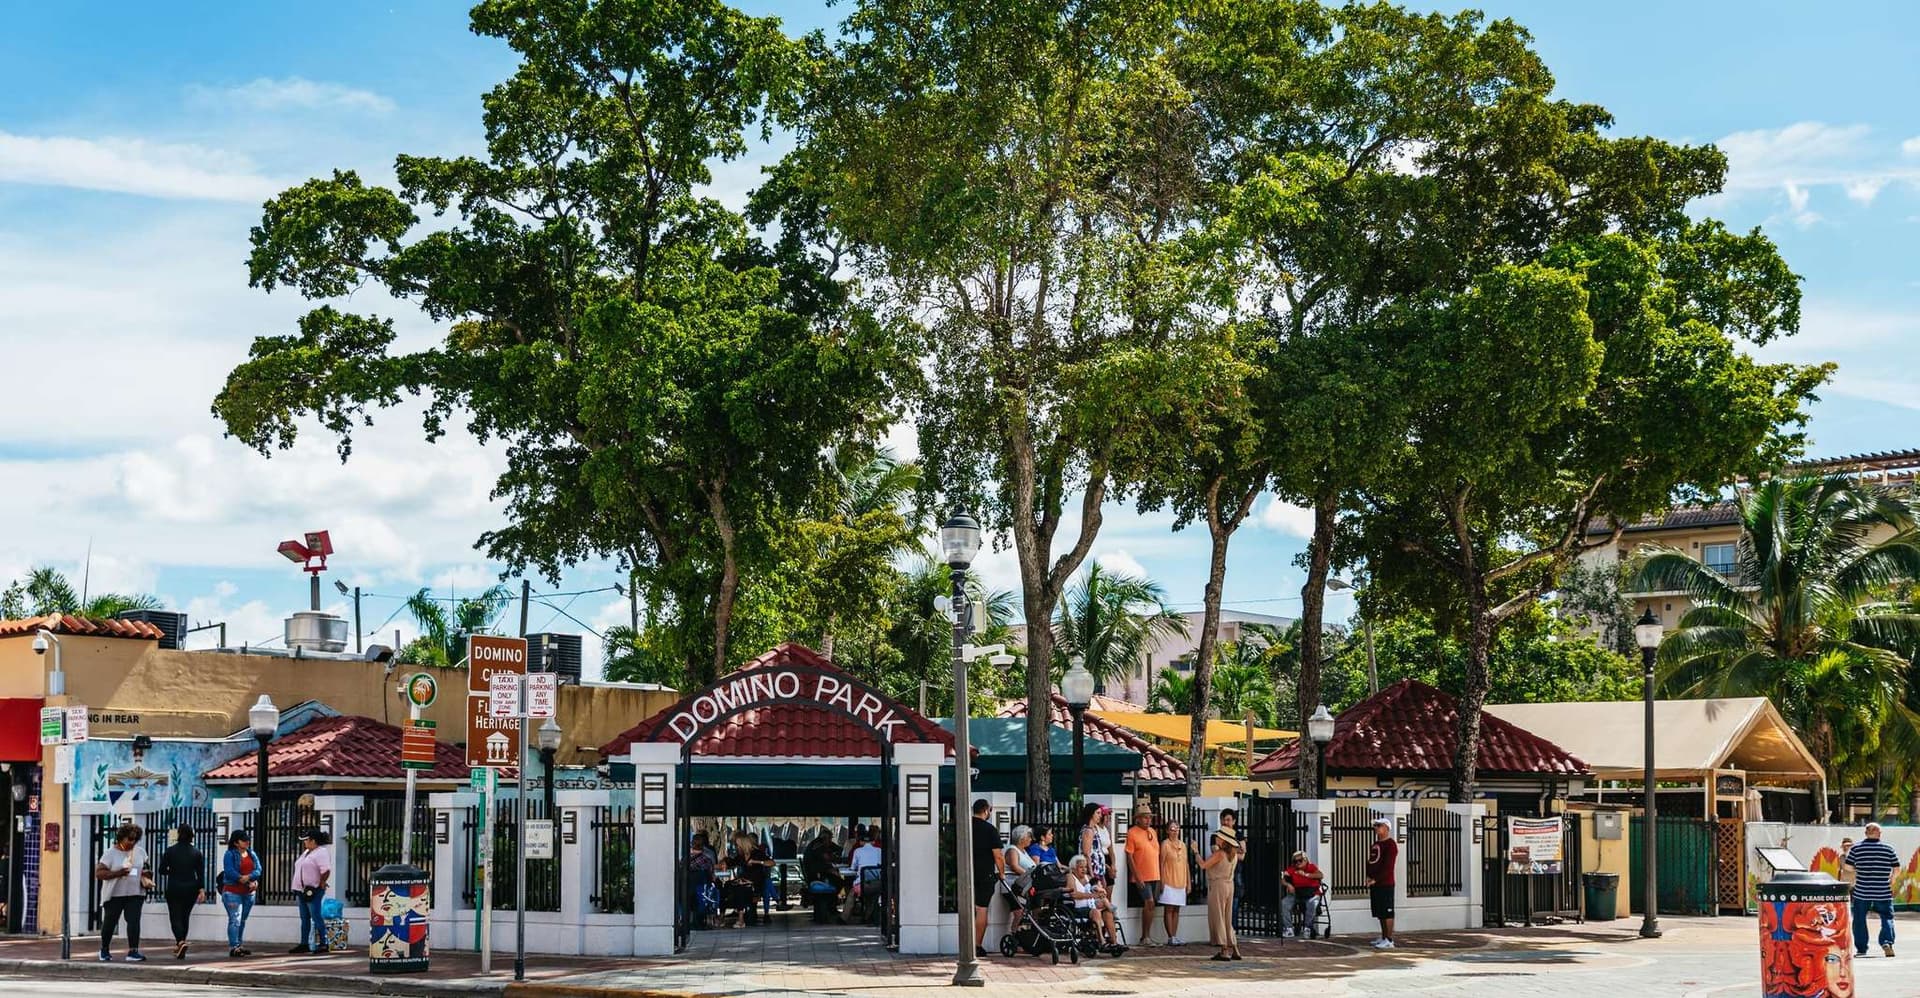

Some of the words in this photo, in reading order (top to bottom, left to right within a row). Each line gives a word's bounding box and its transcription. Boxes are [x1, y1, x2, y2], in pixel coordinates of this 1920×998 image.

[474, 646, 522, 662] DOMINO
[667, 671, 800, 741] DOMINO
[814, 675, 906, 740] PARK
[102, 714, 113, 723] IN
[115, 714, 140, 723] REAR
[475, 715, 521, 730] HERITAGE
